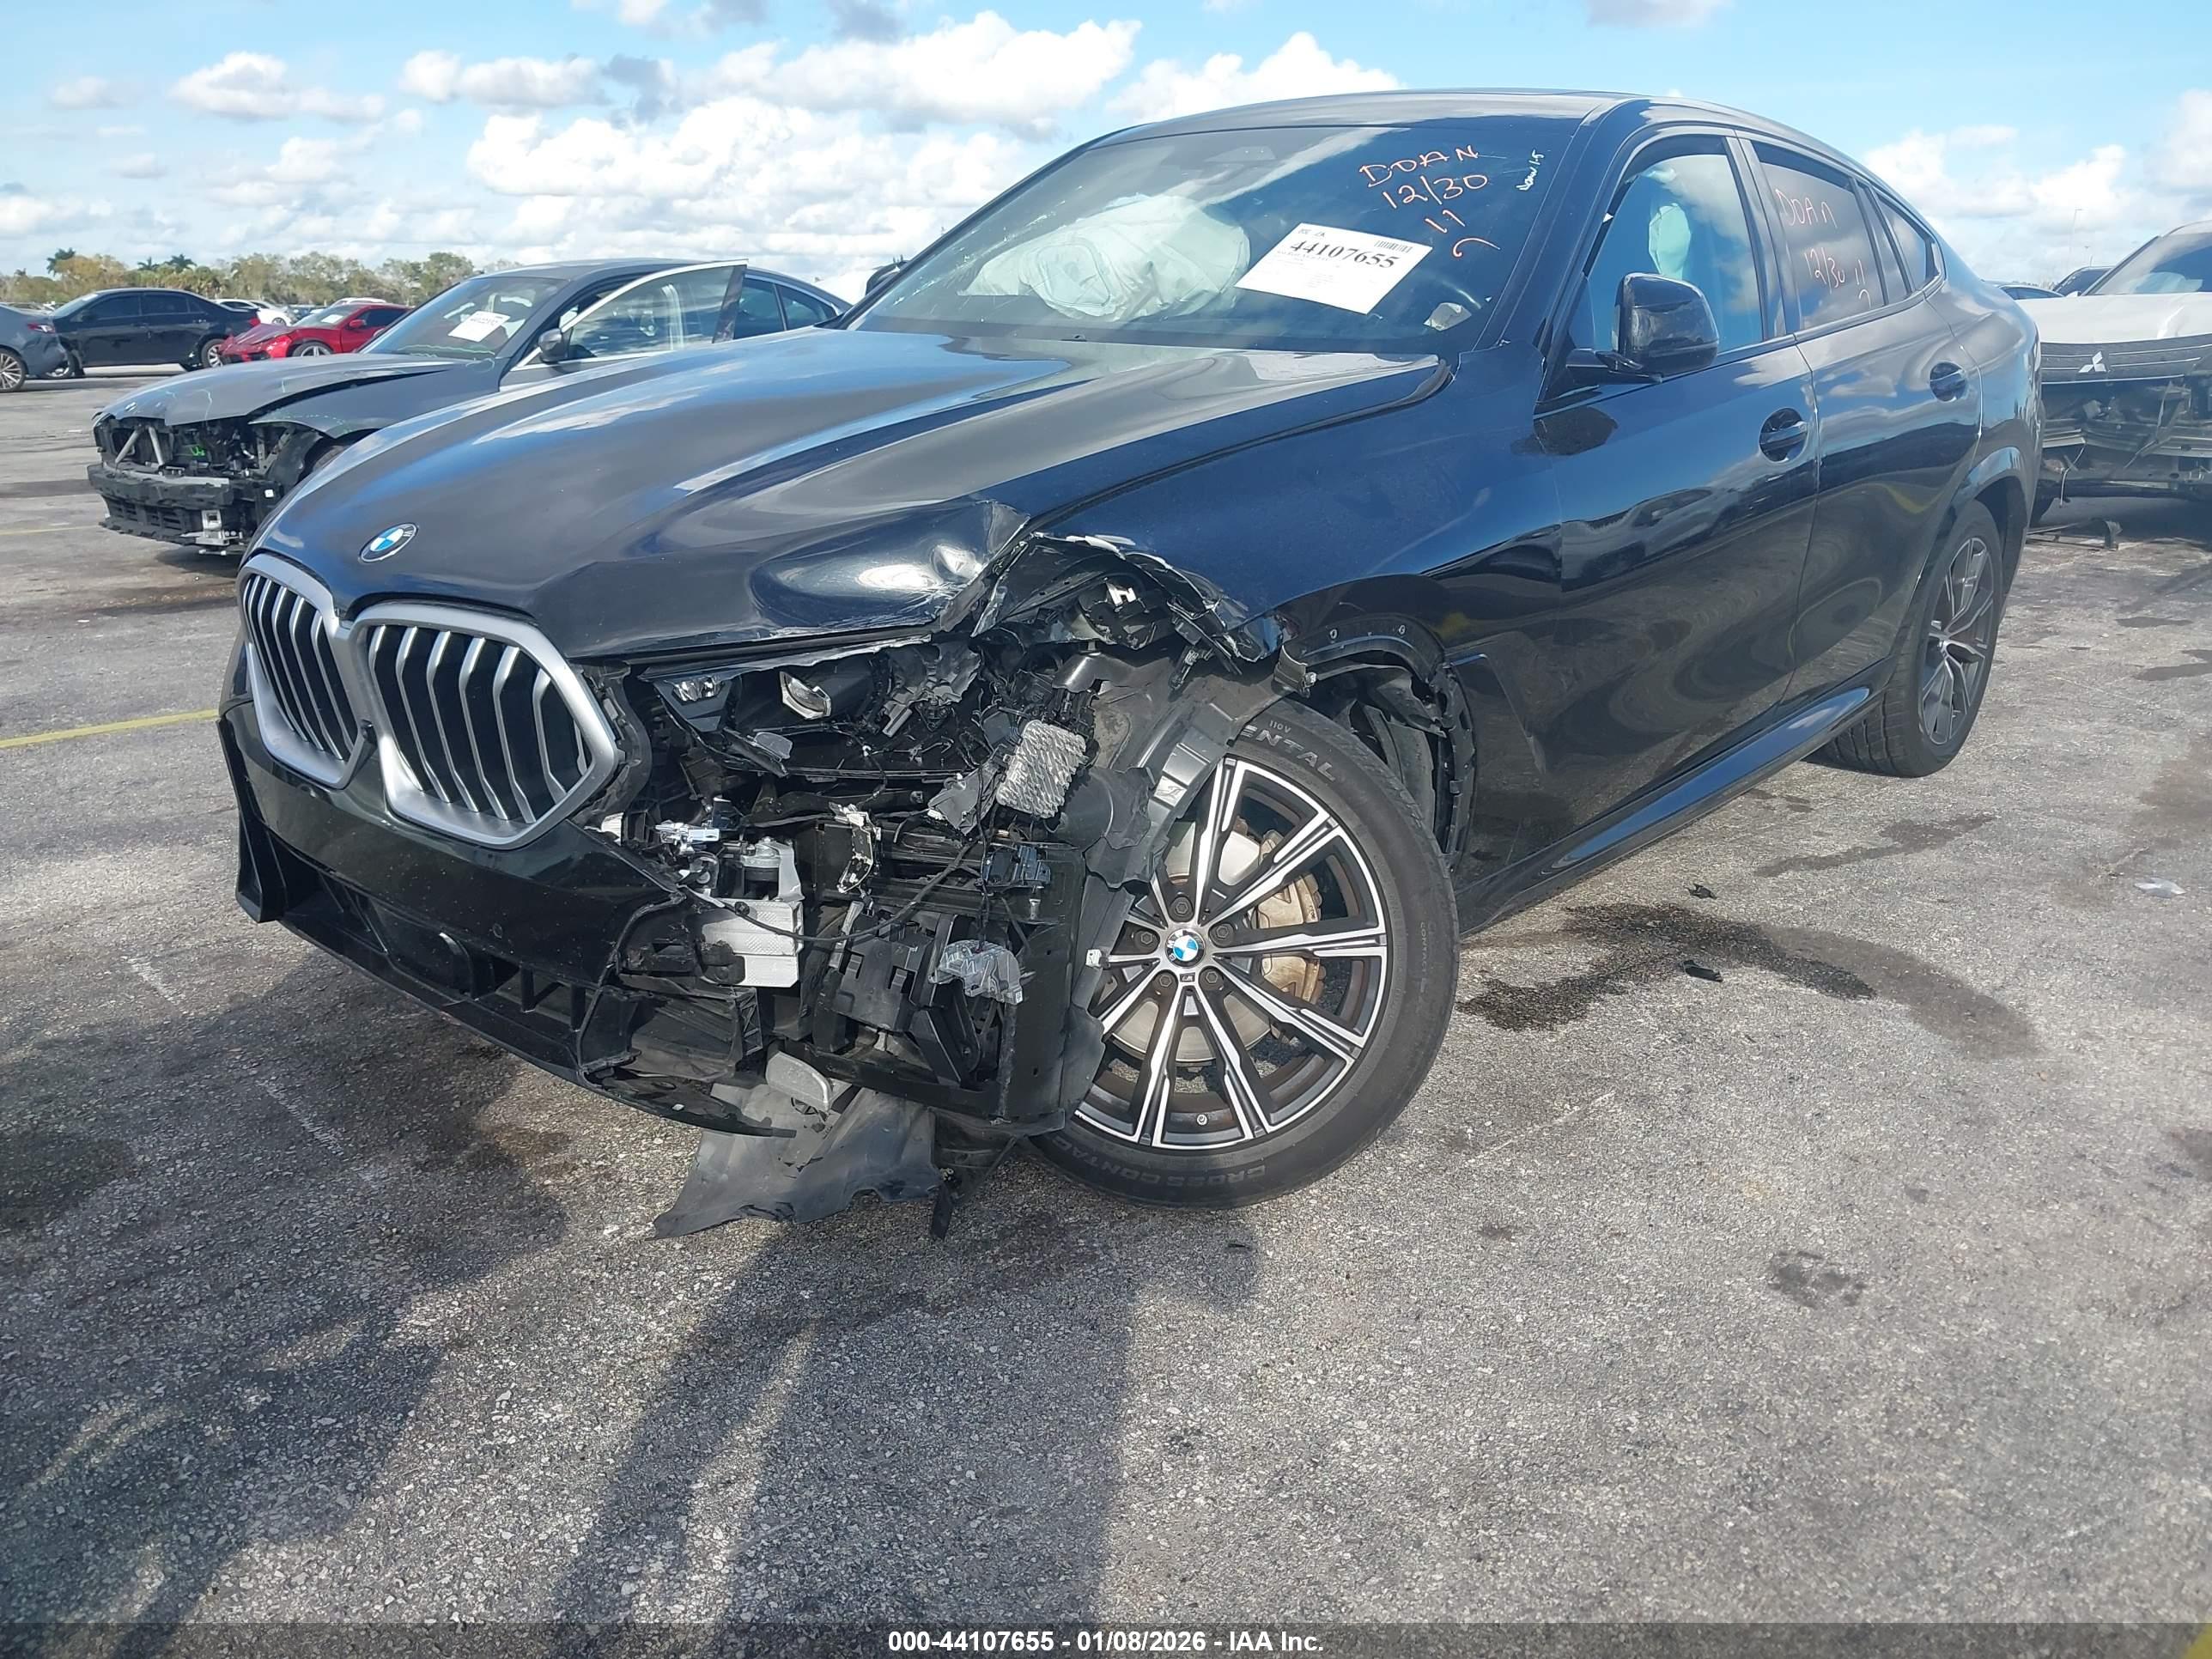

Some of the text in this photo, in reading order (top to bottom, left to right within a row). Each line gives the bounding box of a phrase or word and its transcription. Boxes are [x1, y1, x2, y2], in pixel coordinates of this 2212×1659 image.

[1358, 144, 1479, 188] DOAN
[1382, 174, 1488, 210] 12/30
[1290, 240, 1401, 269] 44107655
[1047, 1133, 1267, 1188] CROSS CONTAC
